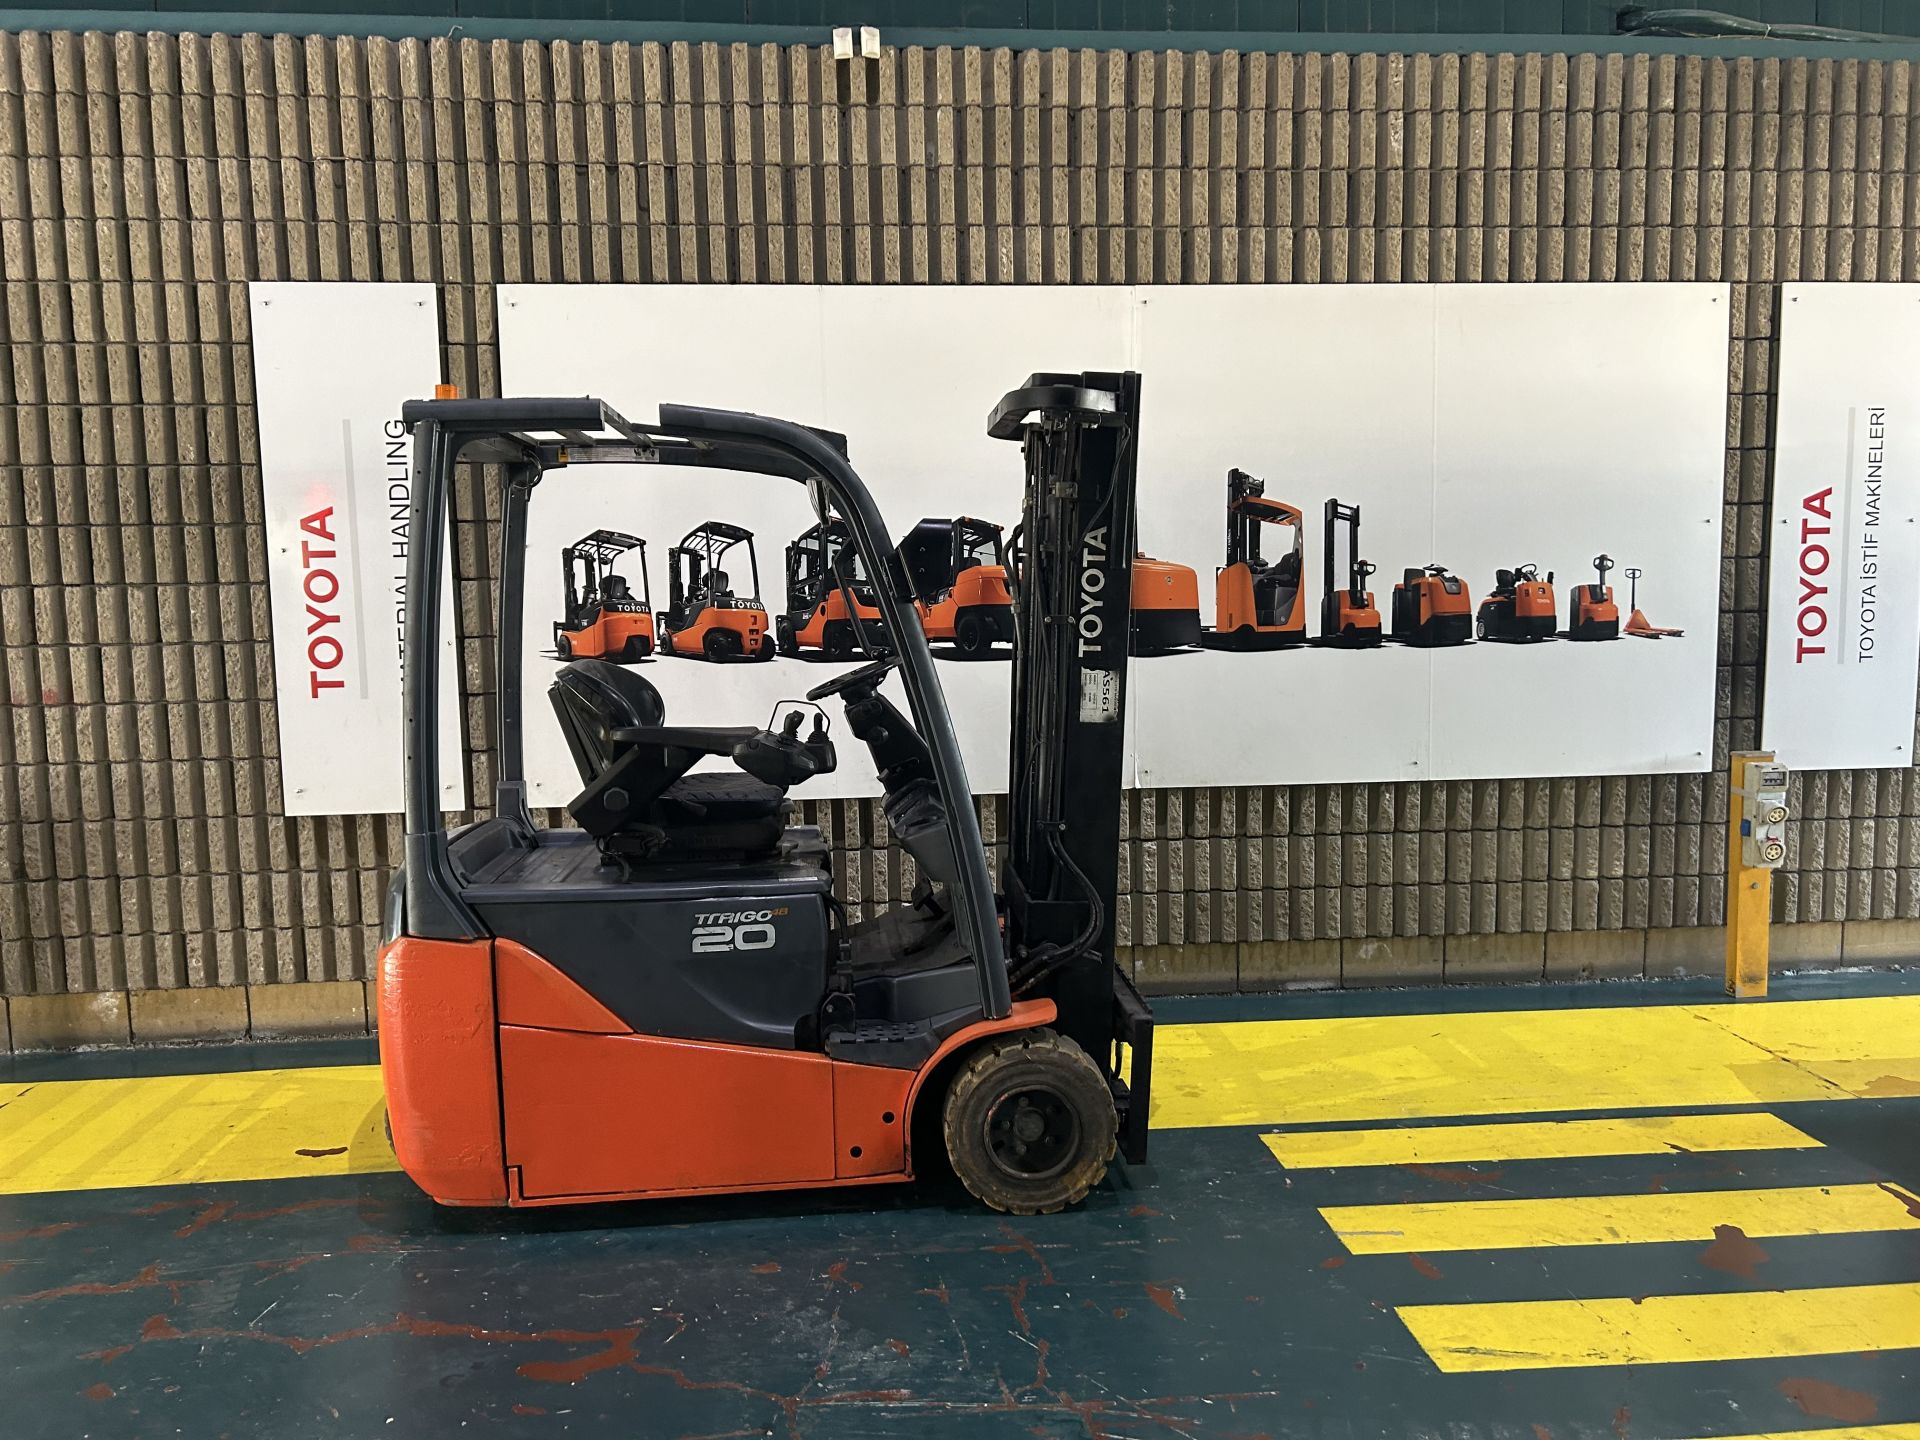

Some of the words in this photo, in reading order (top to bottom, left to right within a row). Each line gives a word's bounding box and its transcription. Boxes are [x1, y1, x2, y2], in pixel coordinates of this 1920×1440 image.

[384, 420, 410, 557] HANDLING
[1864, 408, 1885, 526] MAKİNELERİ
[300, 506, 344, 698] TOYOTA
[1078, 526, 1108, 658] TOYOTA
[1796, 487, 1833, 663] TOYOTA
[1860, 533, 1879, 579] İSTİF
[617, 604, 650, 613] TOYOTA
[1859, 585, 1877, 663] TOYOTA
[1102, 670, 1111, 714] AS561
[691, 923, 776, 953] 20
